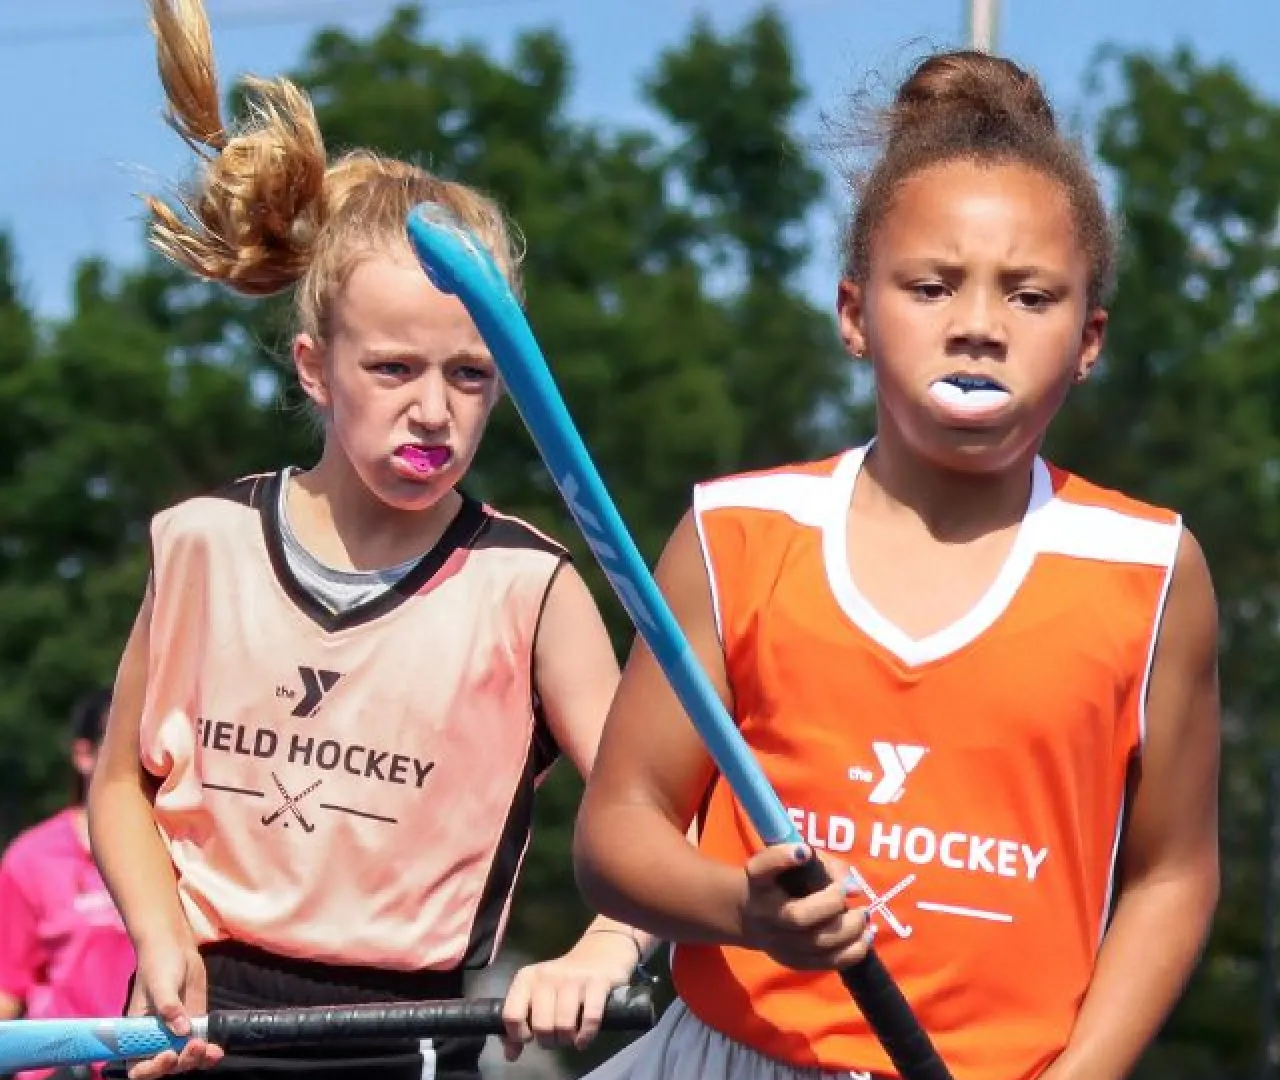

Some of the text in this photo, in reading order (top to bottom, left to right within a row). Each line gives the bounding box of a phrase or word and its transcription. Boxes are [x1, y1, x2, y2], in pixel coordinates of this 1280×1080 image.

[275, 685, 295, 699] the
[287, 734, 435, 788] HOCKEY
[786, 806, 1049, 882] ELD HOCKEY
